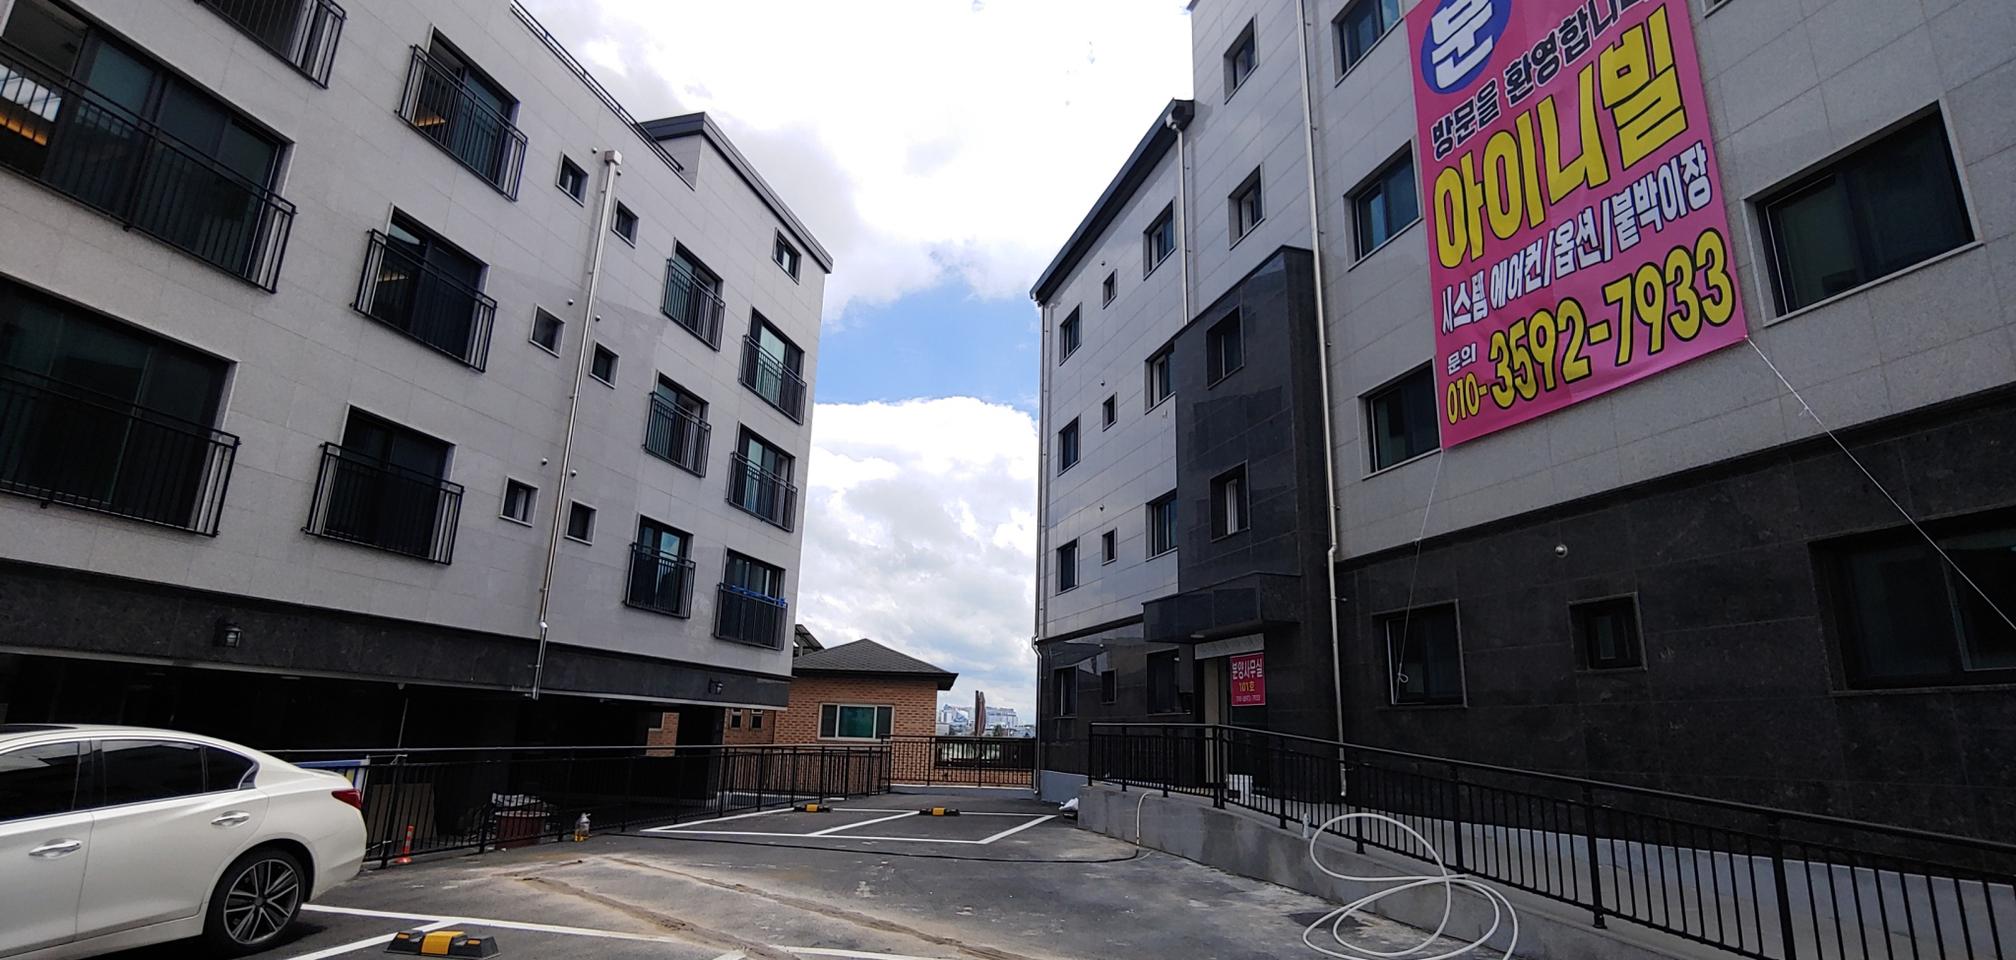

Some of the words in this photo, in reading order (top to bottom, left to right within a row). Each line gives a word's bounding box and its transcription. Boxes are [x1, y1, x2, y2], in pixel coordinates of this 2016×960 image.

[1431, 79, 1500, 161] 방문을
[1504, 0, 1647, 107] 환영합니
[1433, 4, 1688, 268] 아이니빌
[1442, 270, 1489, 335] 시스템
[1446, 228, 1736, 424] 010-3592-7933
[1447, 344, 1478, 376] 문의
[1231, 658, 1263, 680] 분양사무실
[1239, 681, 1256, 692] 101호
